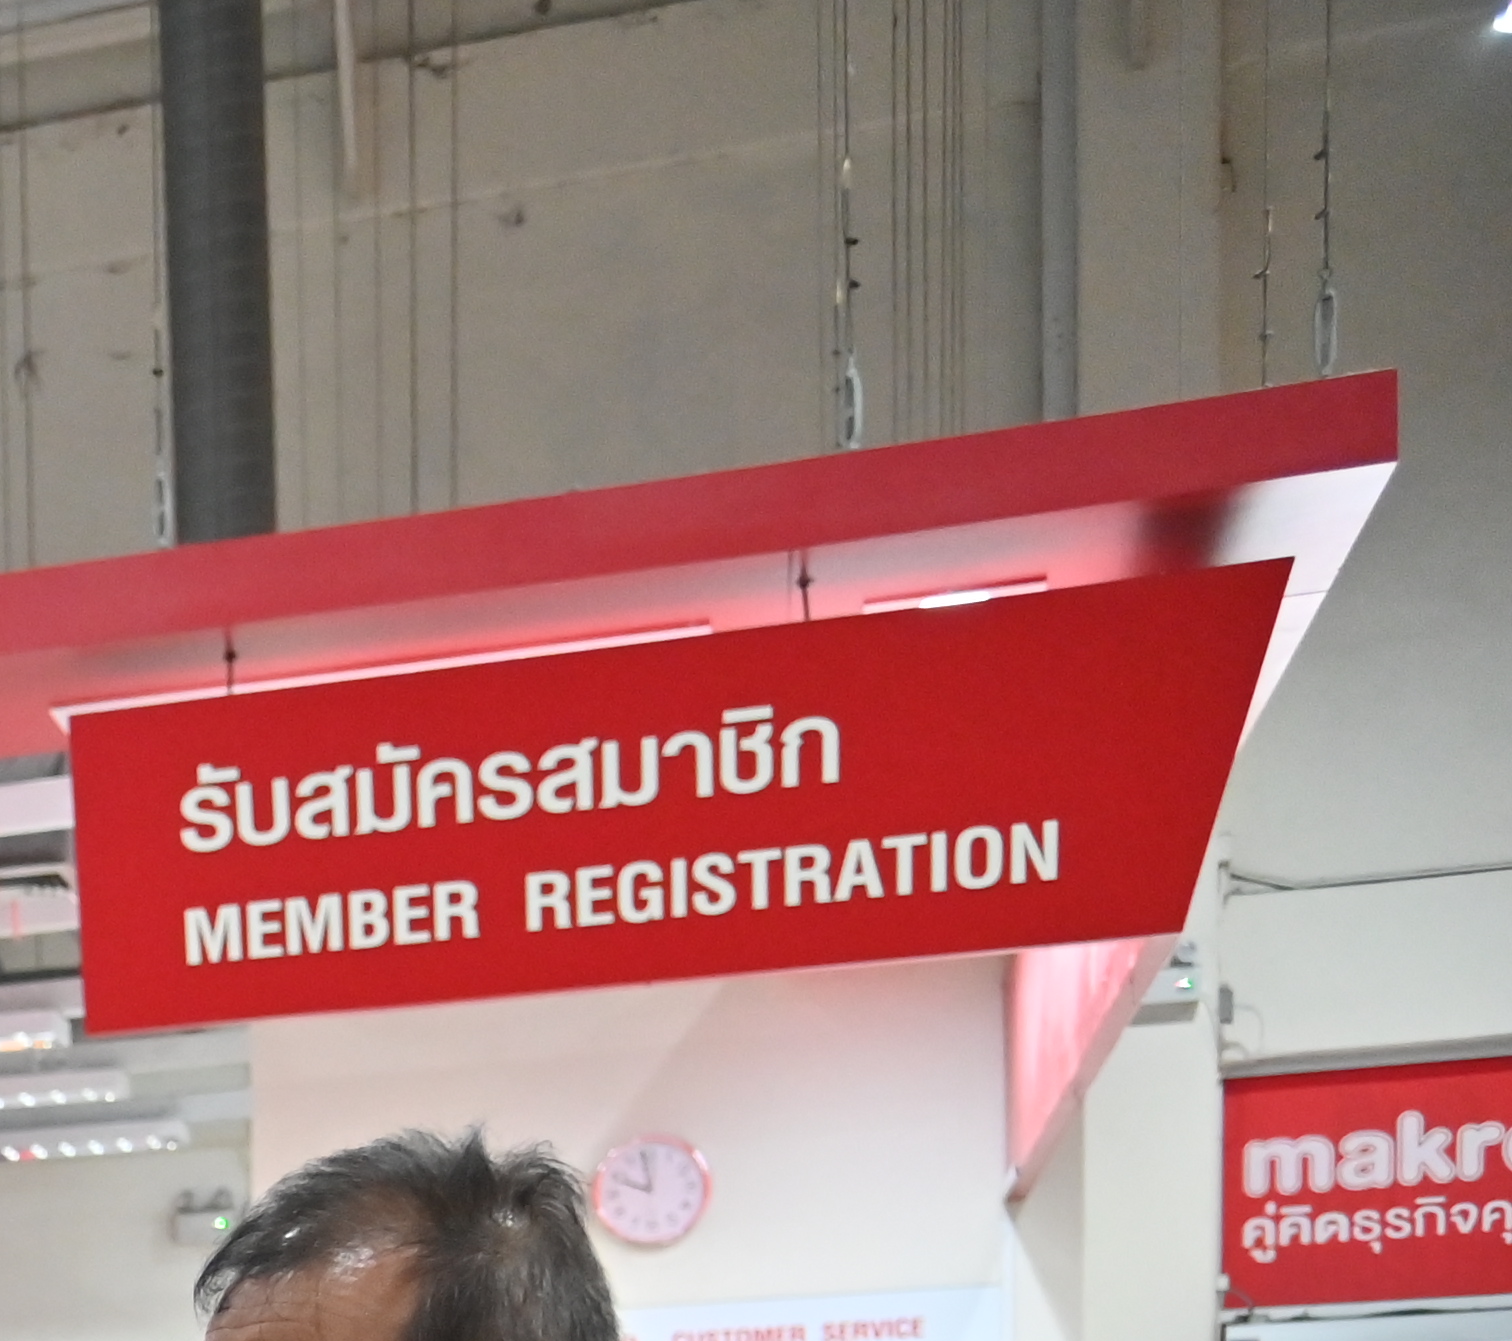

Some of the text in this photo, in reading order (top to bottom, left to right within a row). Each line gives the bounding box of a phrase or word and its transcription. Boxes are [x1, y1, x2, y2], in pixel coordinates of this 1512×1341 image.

[179, 704, 842, 854] รับสมัครสมาชิก
[182, 818, 1063, 967] MEMBER REGISTRATION
